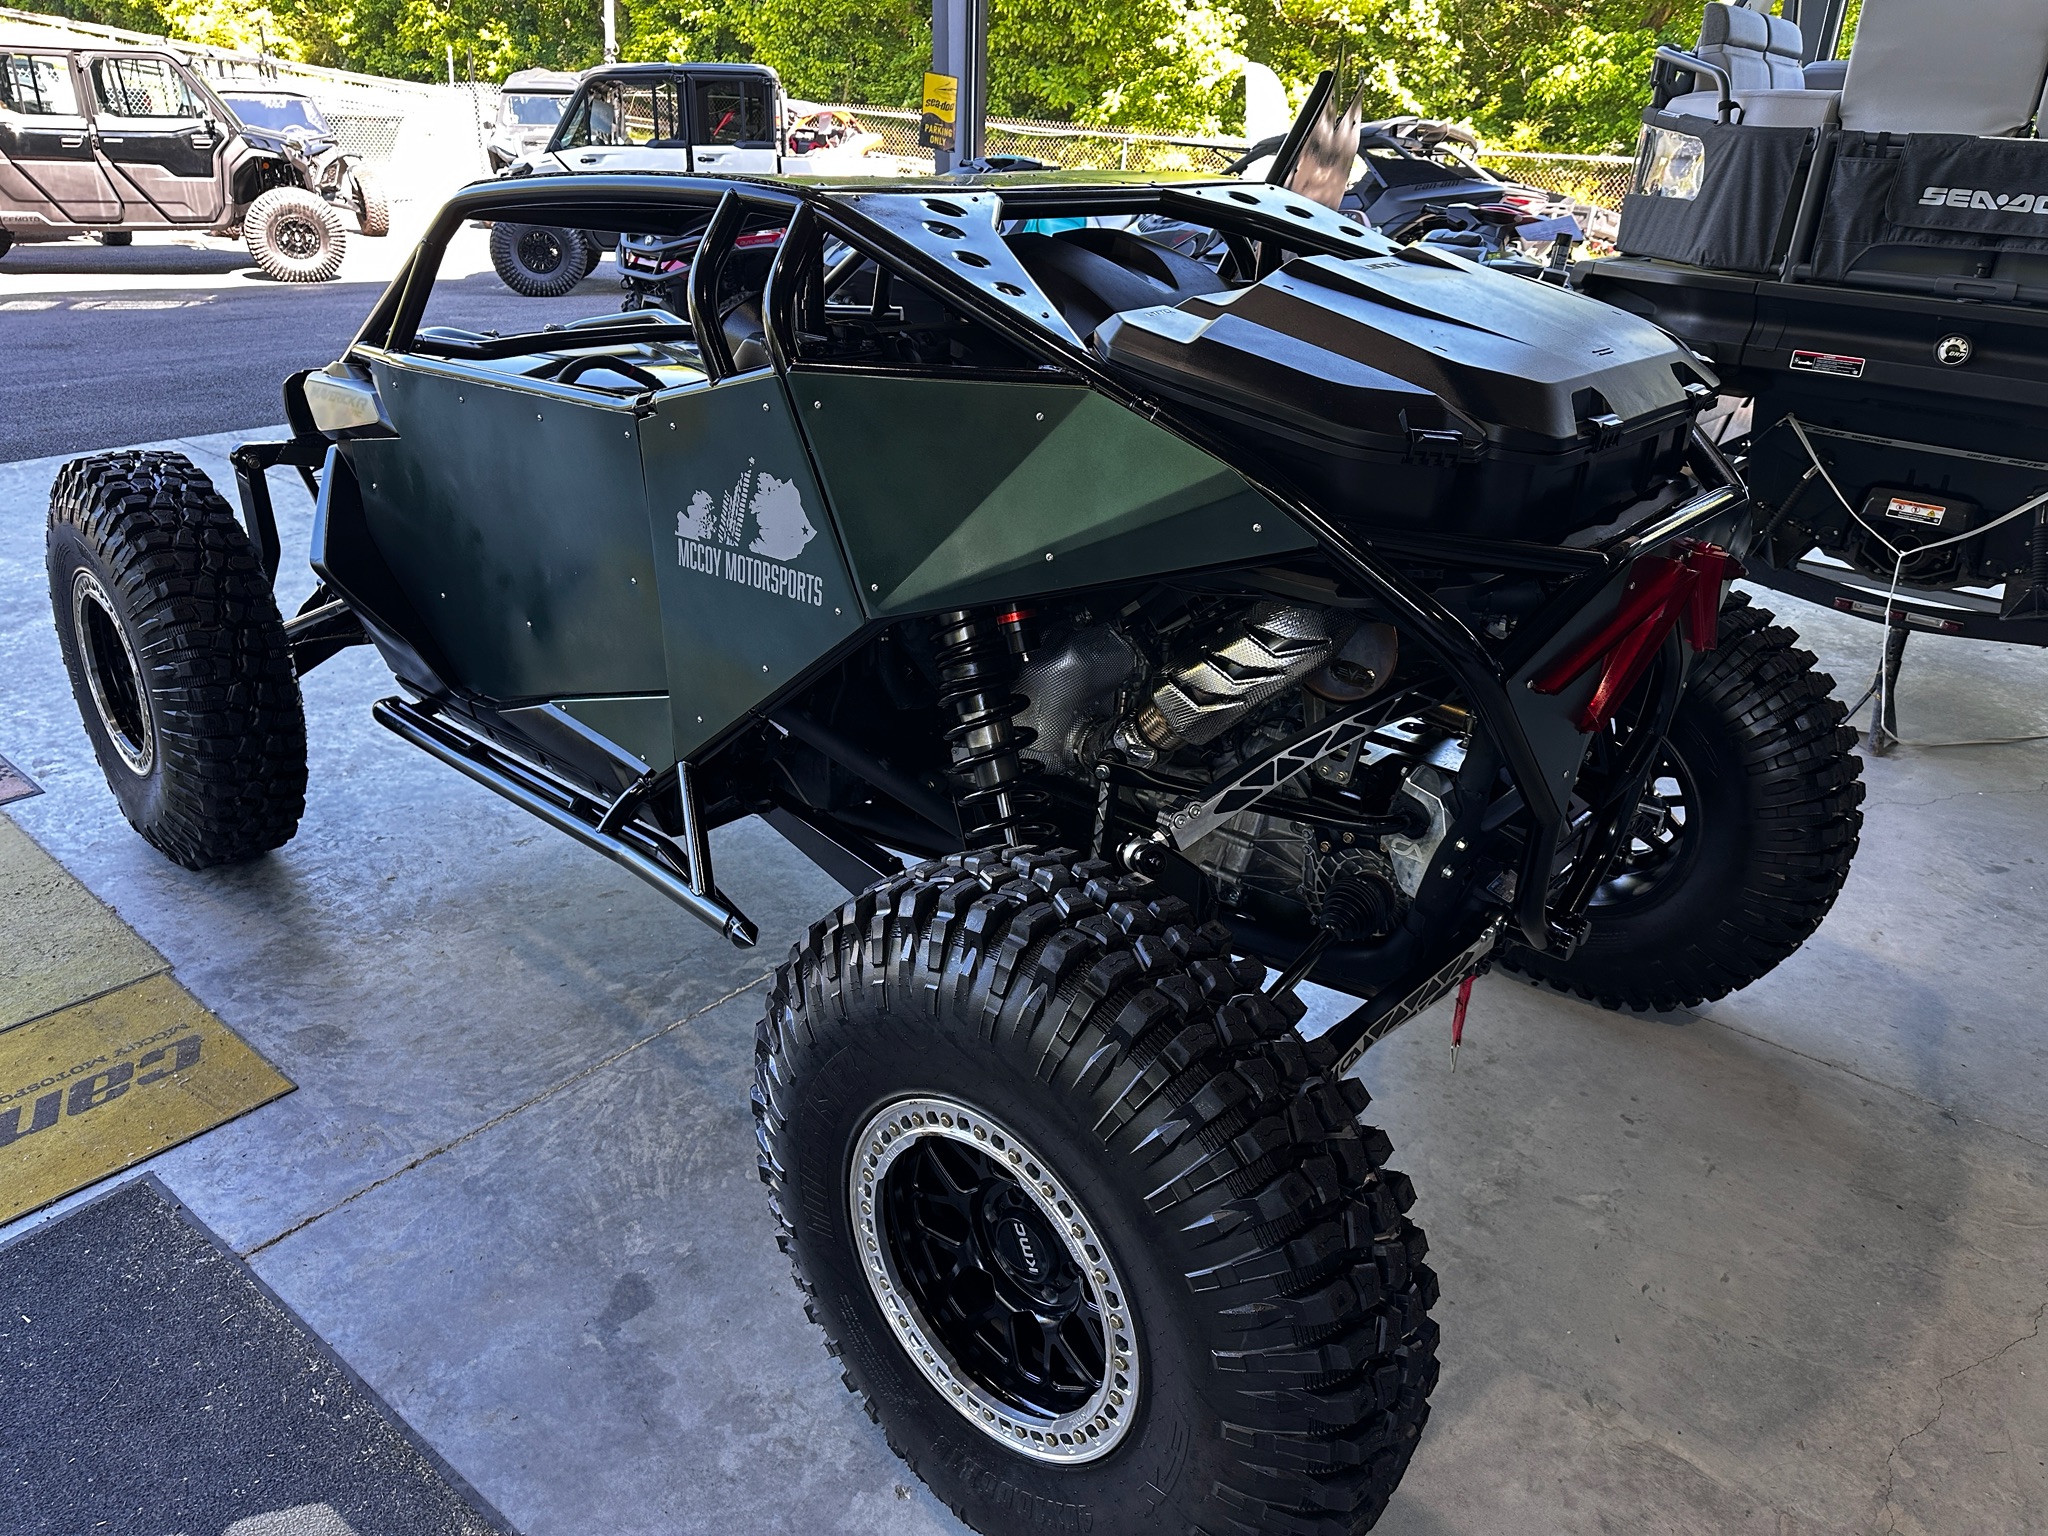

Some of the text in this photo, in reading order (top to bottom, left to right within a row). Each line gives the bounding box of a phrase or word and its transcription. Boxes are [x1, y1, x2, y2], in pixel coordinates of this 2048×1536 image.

[924, 123, 953, 137] PARKING
[929, 135, 947, 147] ONLY
[678, 538, 823, 607] MCCOY MOTORSPORTS
[115, 1022, 190, 1057] MCCOY
